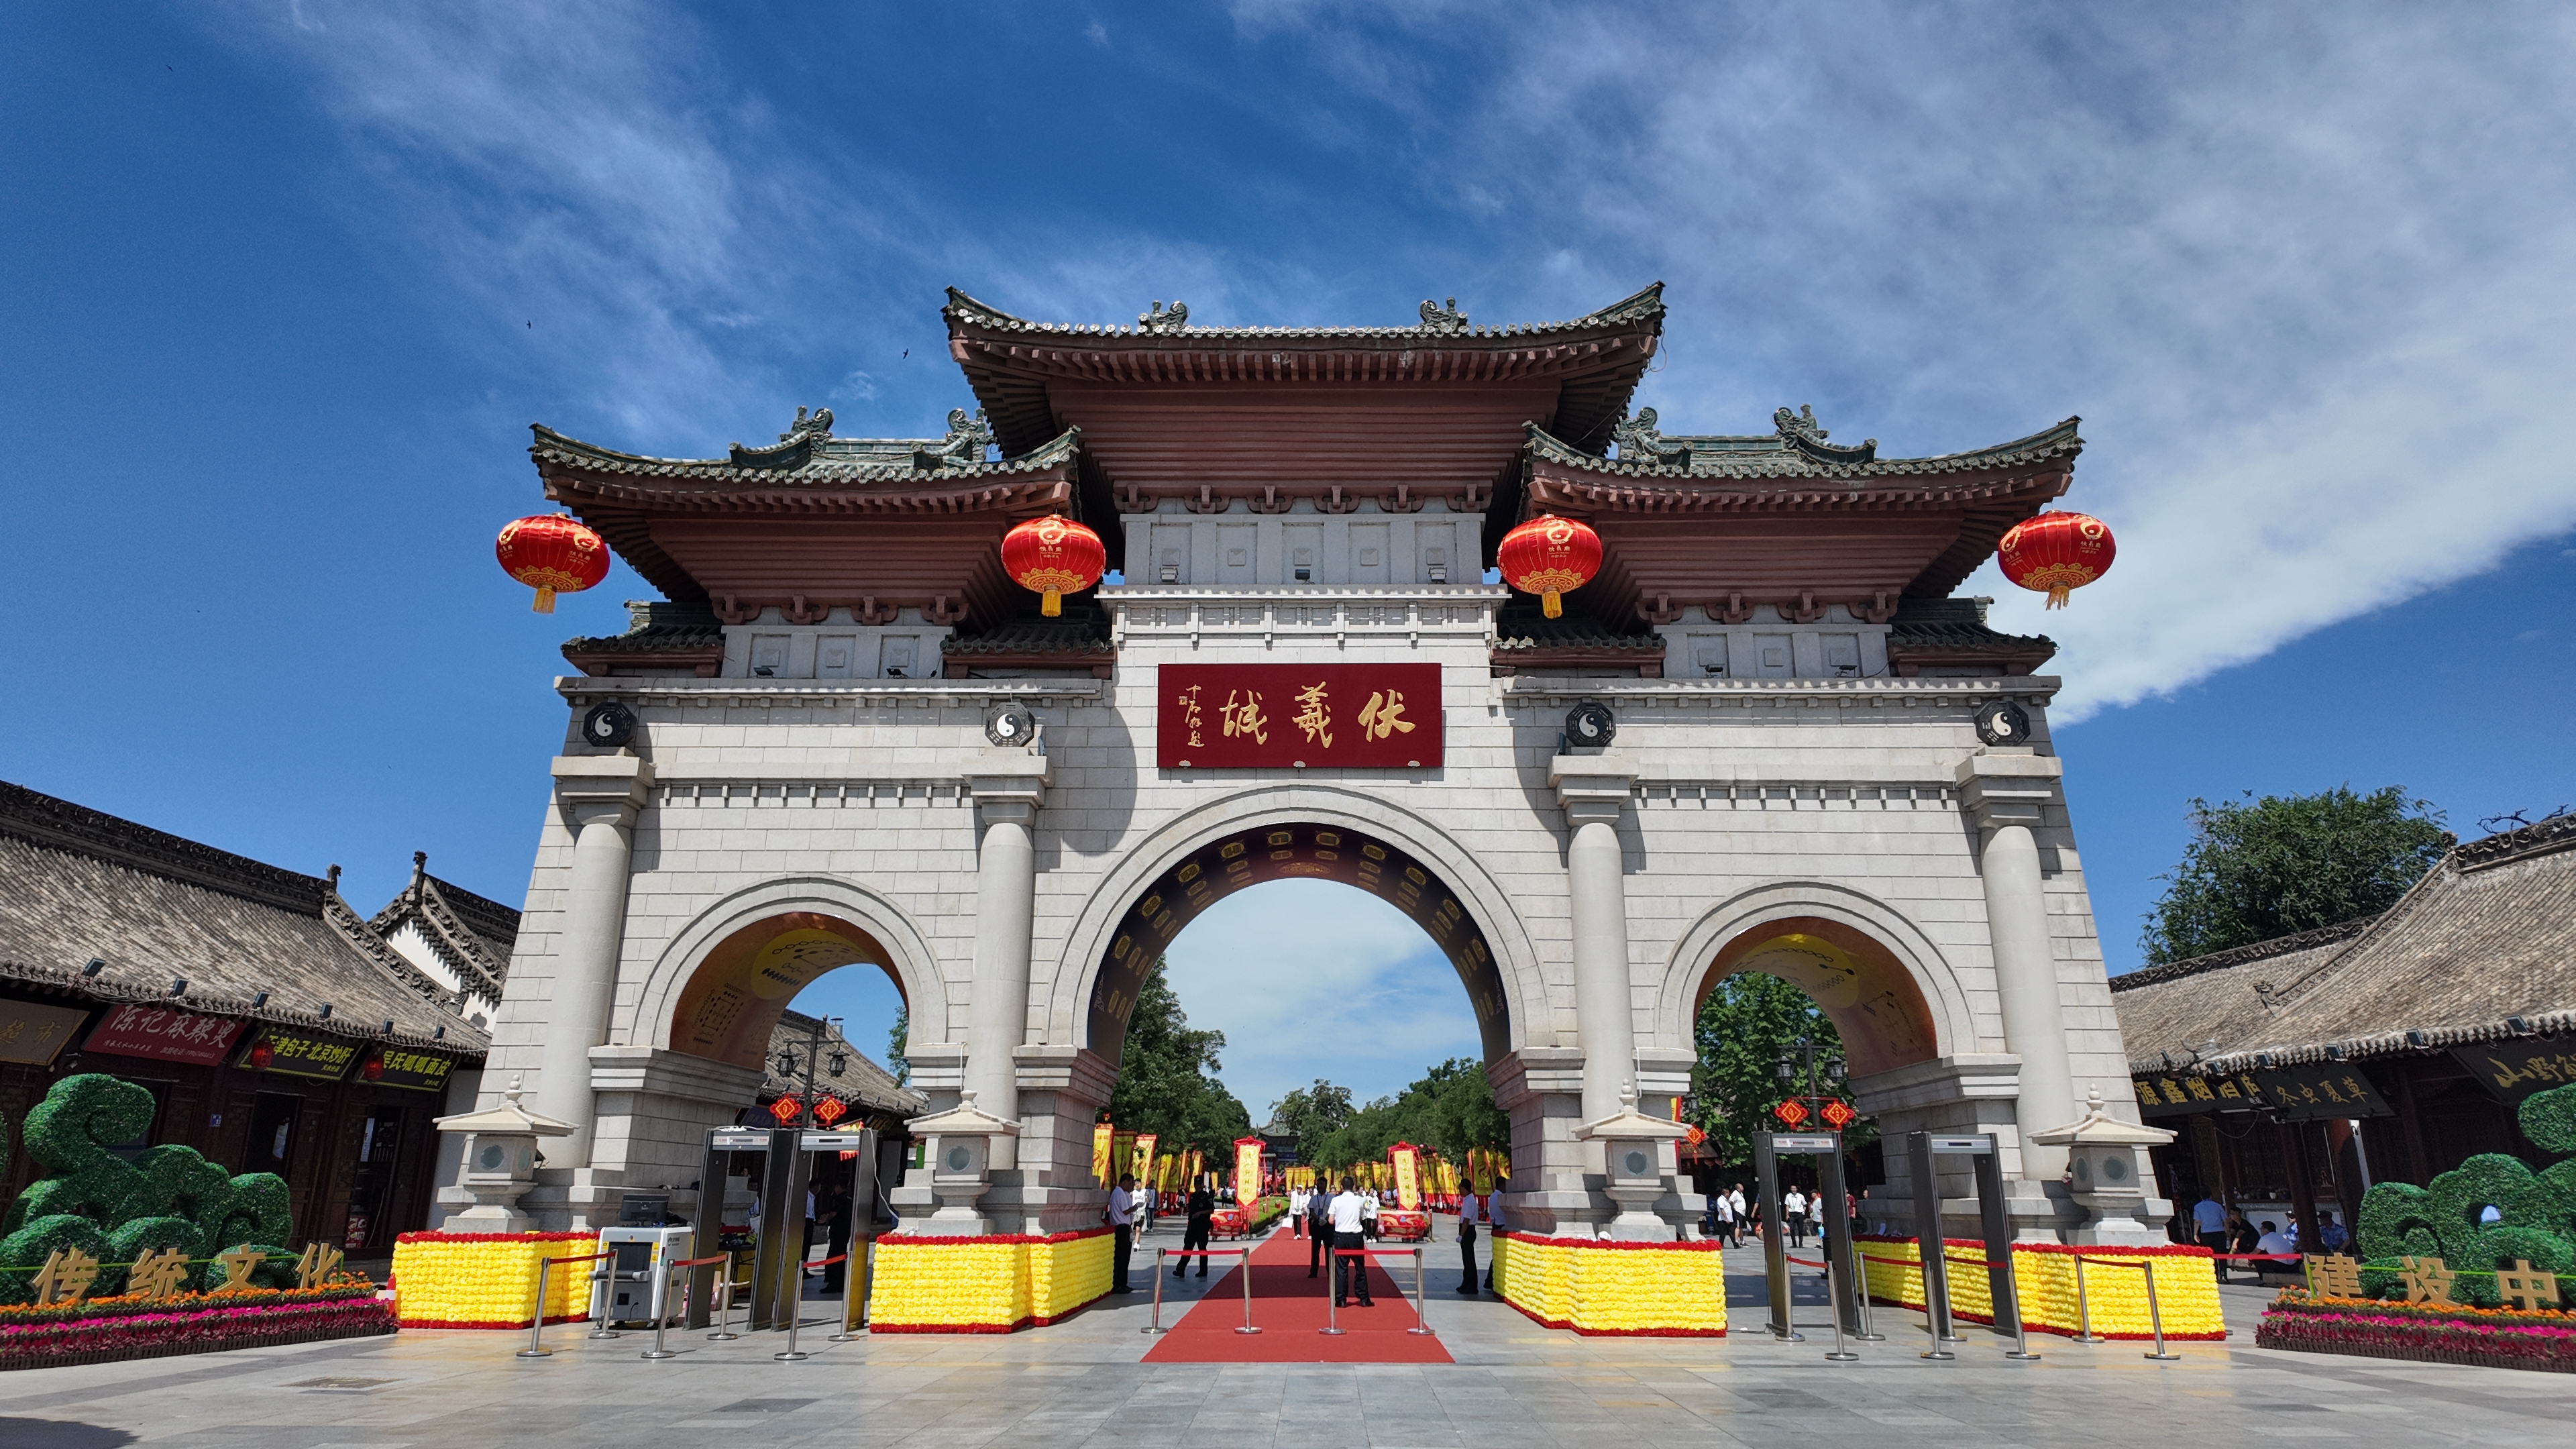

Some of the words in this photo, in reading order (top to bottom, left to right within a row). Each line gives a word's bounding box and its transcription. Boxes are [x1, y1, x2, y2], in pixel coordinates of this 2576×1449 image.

[2275, 1075, 2369, 1107] 冬虫夏草
[32, 1242, 343, 1307] 传统文化
[2308, 1252, 2562, 1312] 建设中
